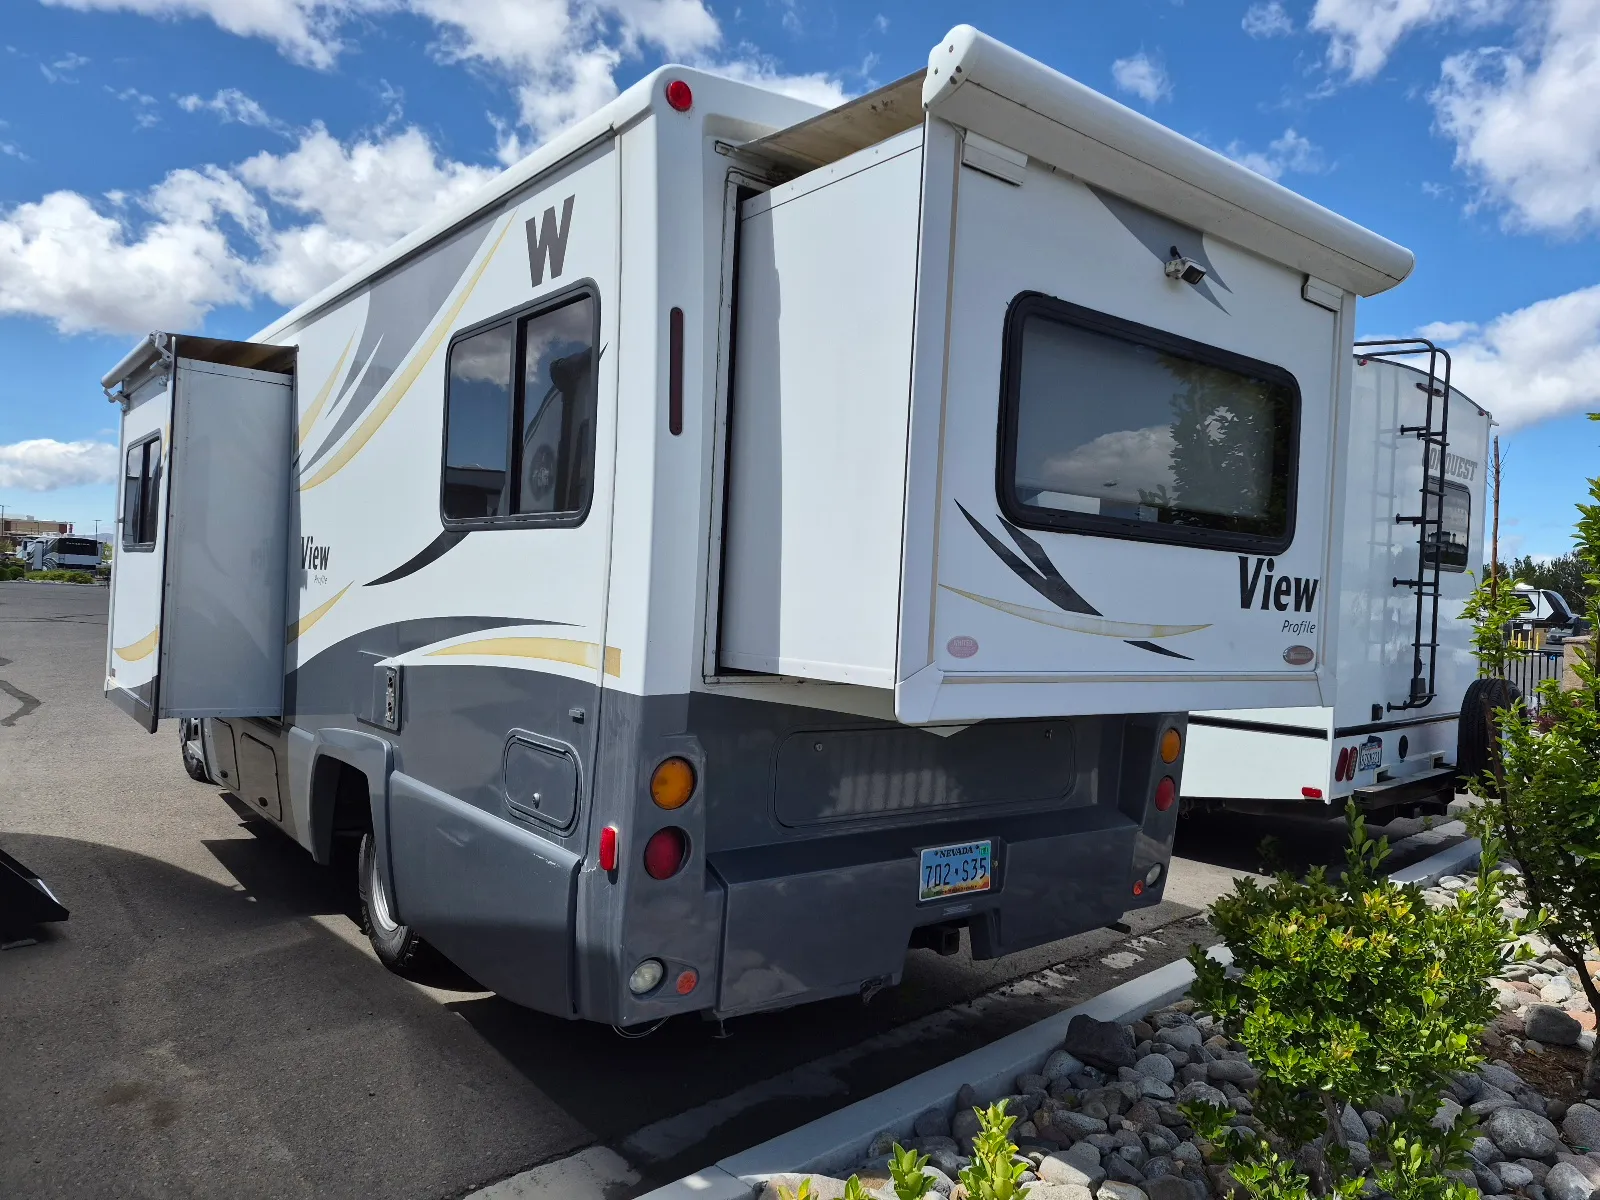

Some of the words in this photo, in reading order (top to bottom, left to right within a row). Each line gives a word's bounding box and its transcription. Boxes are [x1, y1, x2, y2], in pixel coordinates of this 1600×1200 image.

[525, 193, 575, 288] W
[1422, 448, 1478, 482] OQUEST
[301, 536, 330, 570] View
[1238, 556, 1319, 612] View
[1281, 620, 1316, 636] Profile
[939, 846, 974, 858] NEVADA
